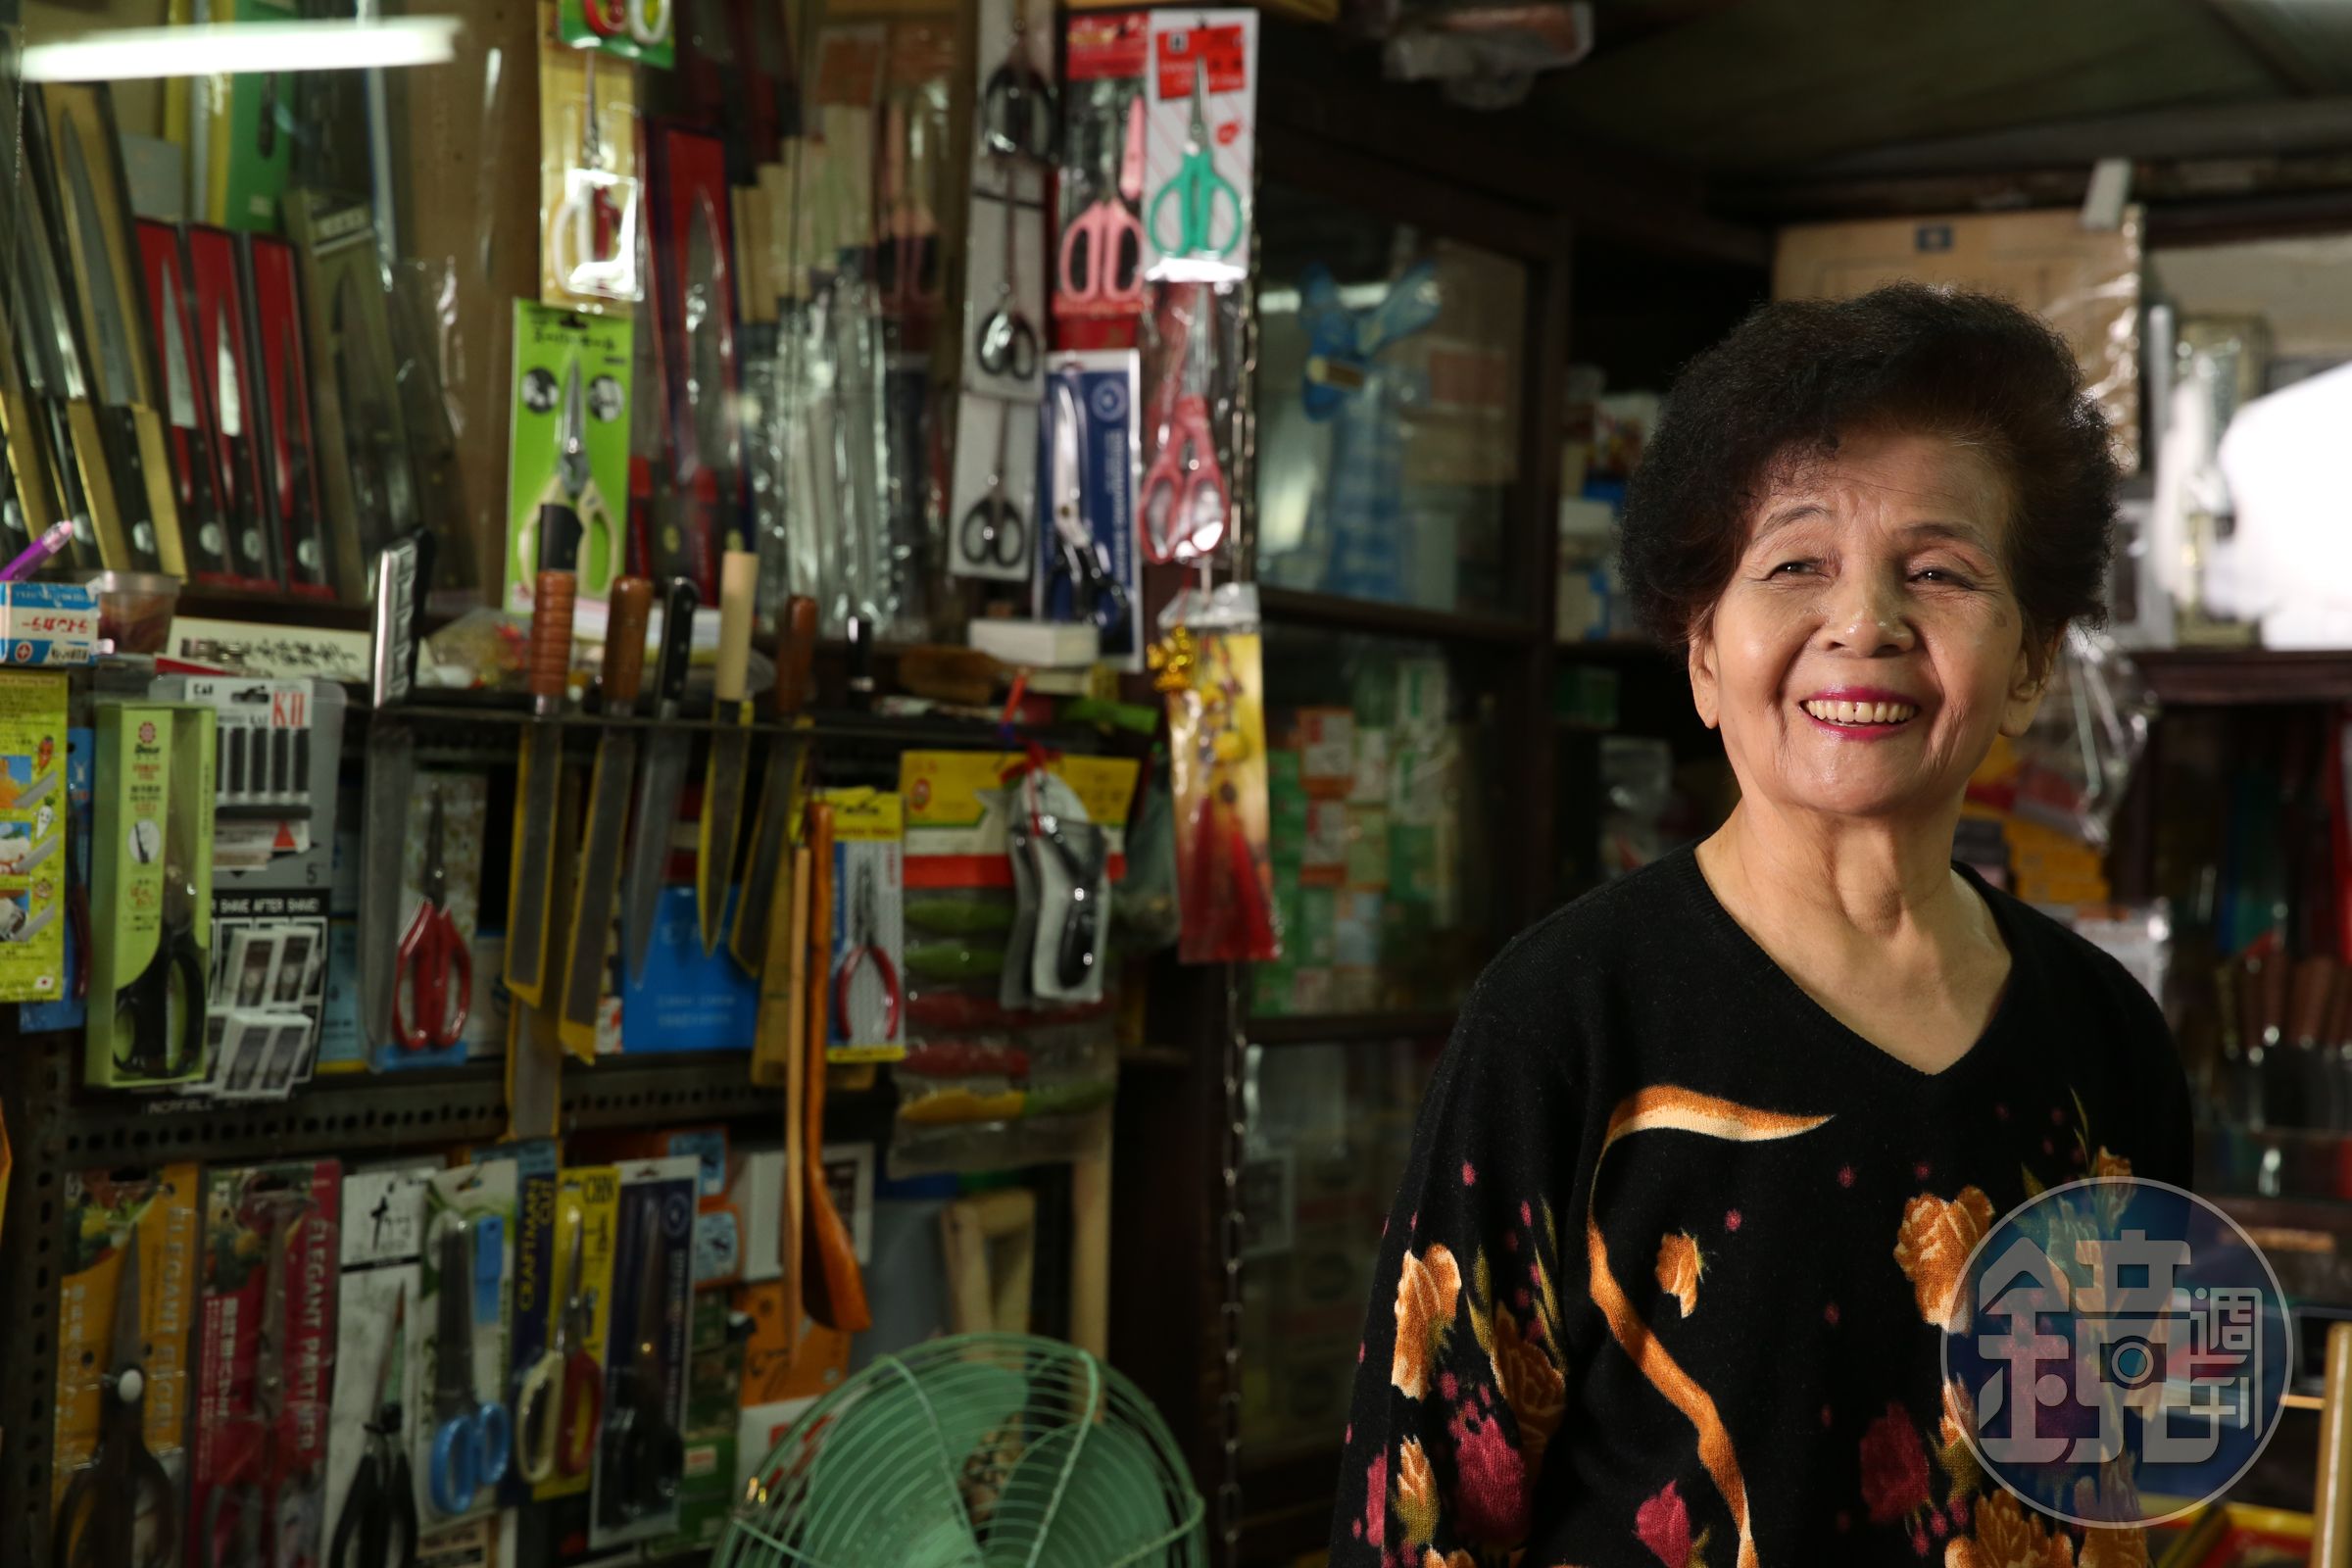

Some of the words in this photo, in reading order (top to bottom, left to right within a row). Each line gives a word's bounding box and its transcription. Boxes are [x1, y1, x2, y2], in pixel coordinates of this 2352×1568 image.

[253, 898, 284, 912] AFTER
[159, 1207, 186, 1335] ELEGANT
[303, 1218, 328, 1329] ELEGANT
[297, 1337, 321, 1450] PARTNER
